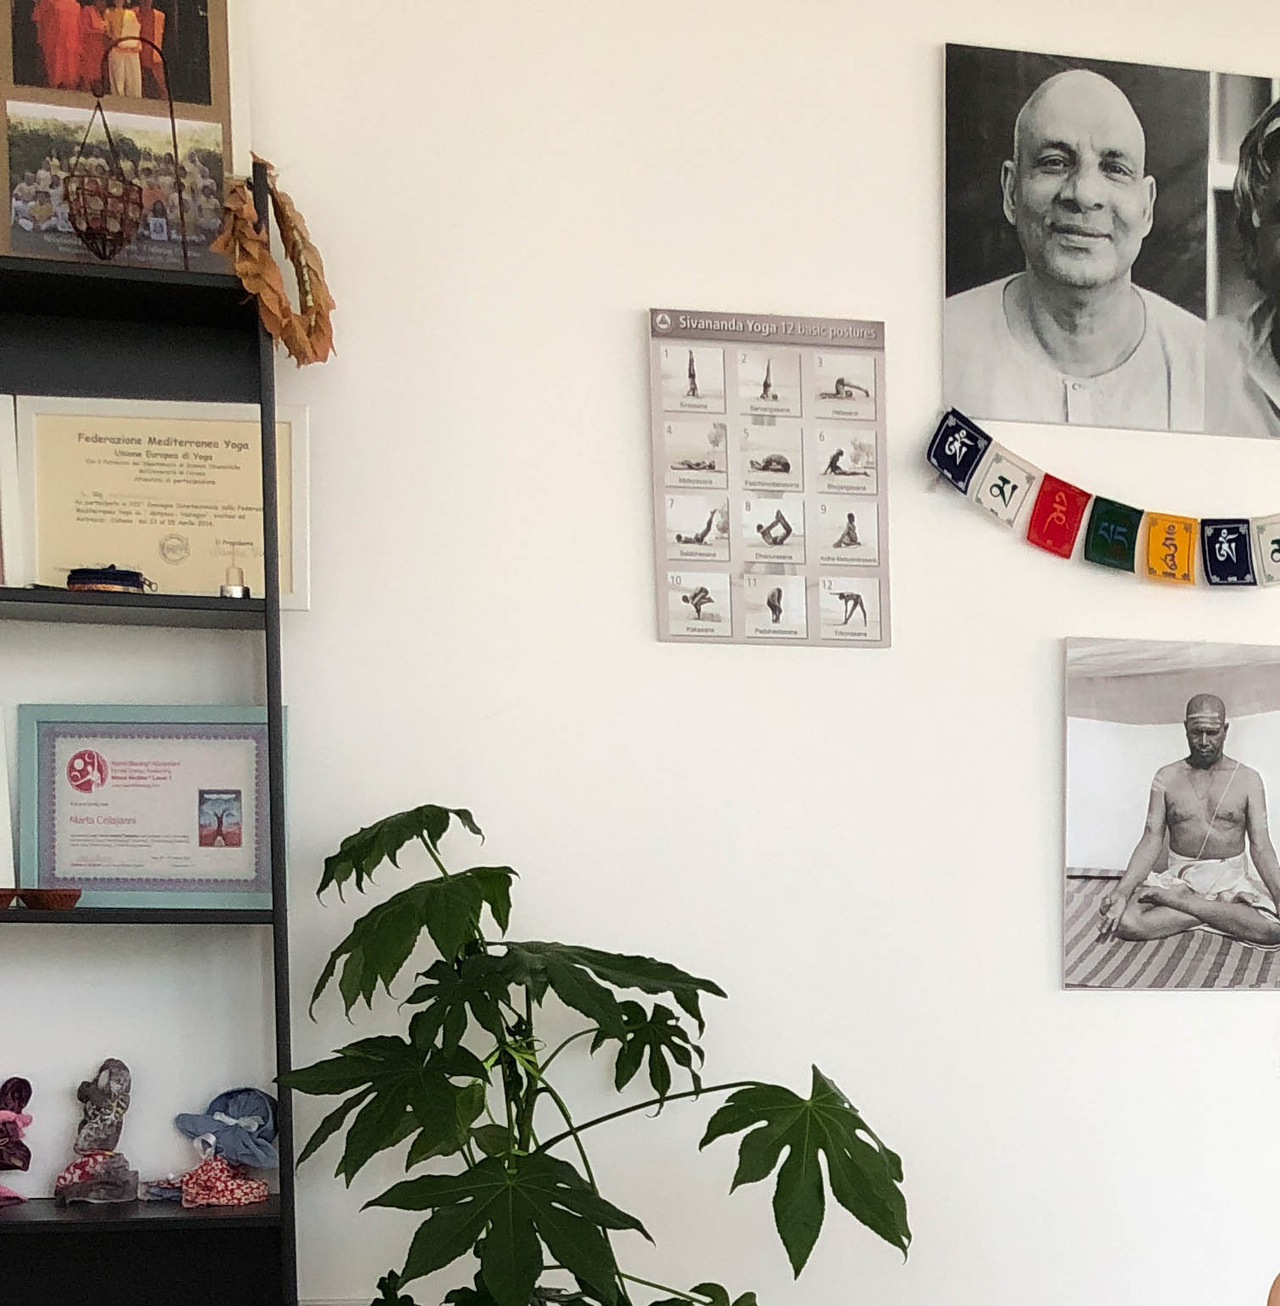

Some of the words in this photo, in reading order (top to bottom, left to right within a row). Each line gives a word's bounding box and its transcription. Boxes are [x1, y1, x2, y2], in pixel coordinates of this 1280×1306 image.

[679, 316, 743, 332] Sivananda
[747, 319, 777, 335] Yoga
[781, 322, 795, 334] 12
[798, 323, 826, 336] basic
[829, 326, 876, 340] postures
[741, 353, 747, 363] 2
[817, 357, 823, 367] 3
[666, 425, 672, 435] 4
[743, 428, 749, 439] 5
[77, 433, 143, 445] Federazione
[147, 437, 219, 449] Mediterranea
[224, 440, 249, 451] Yoga
[819, 432, 825, 442] 6
[145, 451, 178, 460] Europea
[193, 453, 213, 461] Yoga
[669, 499, 675, 509] 7
[745, 501, 751, 512] 8
[821, 504, 827, 515] 9
[671, 575, 682, 585] 10
[747, 577, 758, 588] 11
[822, 580, 833, 590] 12
[69, 816, 95, 825] Marta
